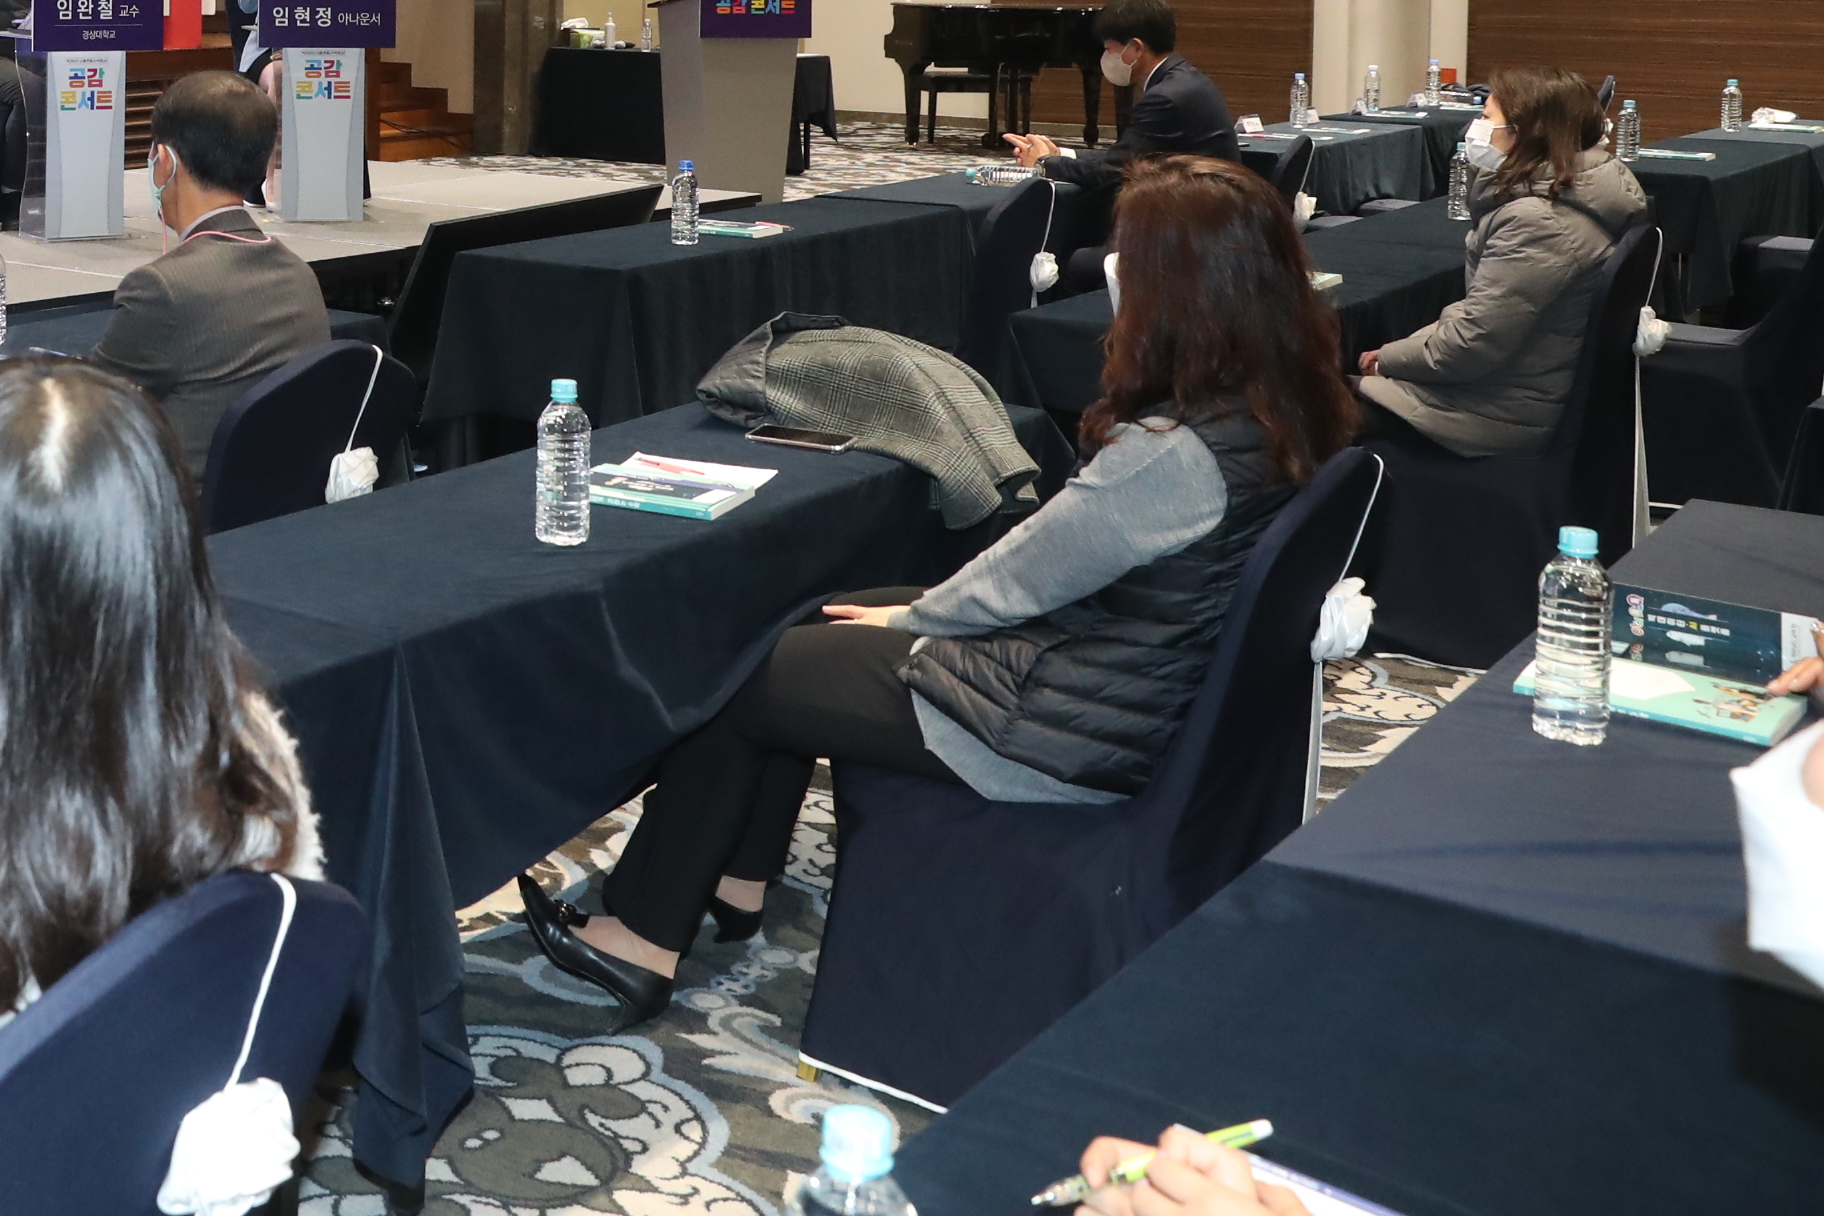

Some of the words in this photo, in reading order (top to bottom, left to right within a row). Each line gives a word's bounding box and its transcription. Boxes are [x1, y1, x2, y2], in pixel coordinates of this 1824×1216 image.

[119, 5, 140, 18] 교수
[337, 12, 381, 26] 아나운서
[69, 68, 105, 88] 공감
[304, 60, 343, 79] 공감
[295, 81, 351, 100] 콘서트
[60, 91, 113, 111] 콘서트
